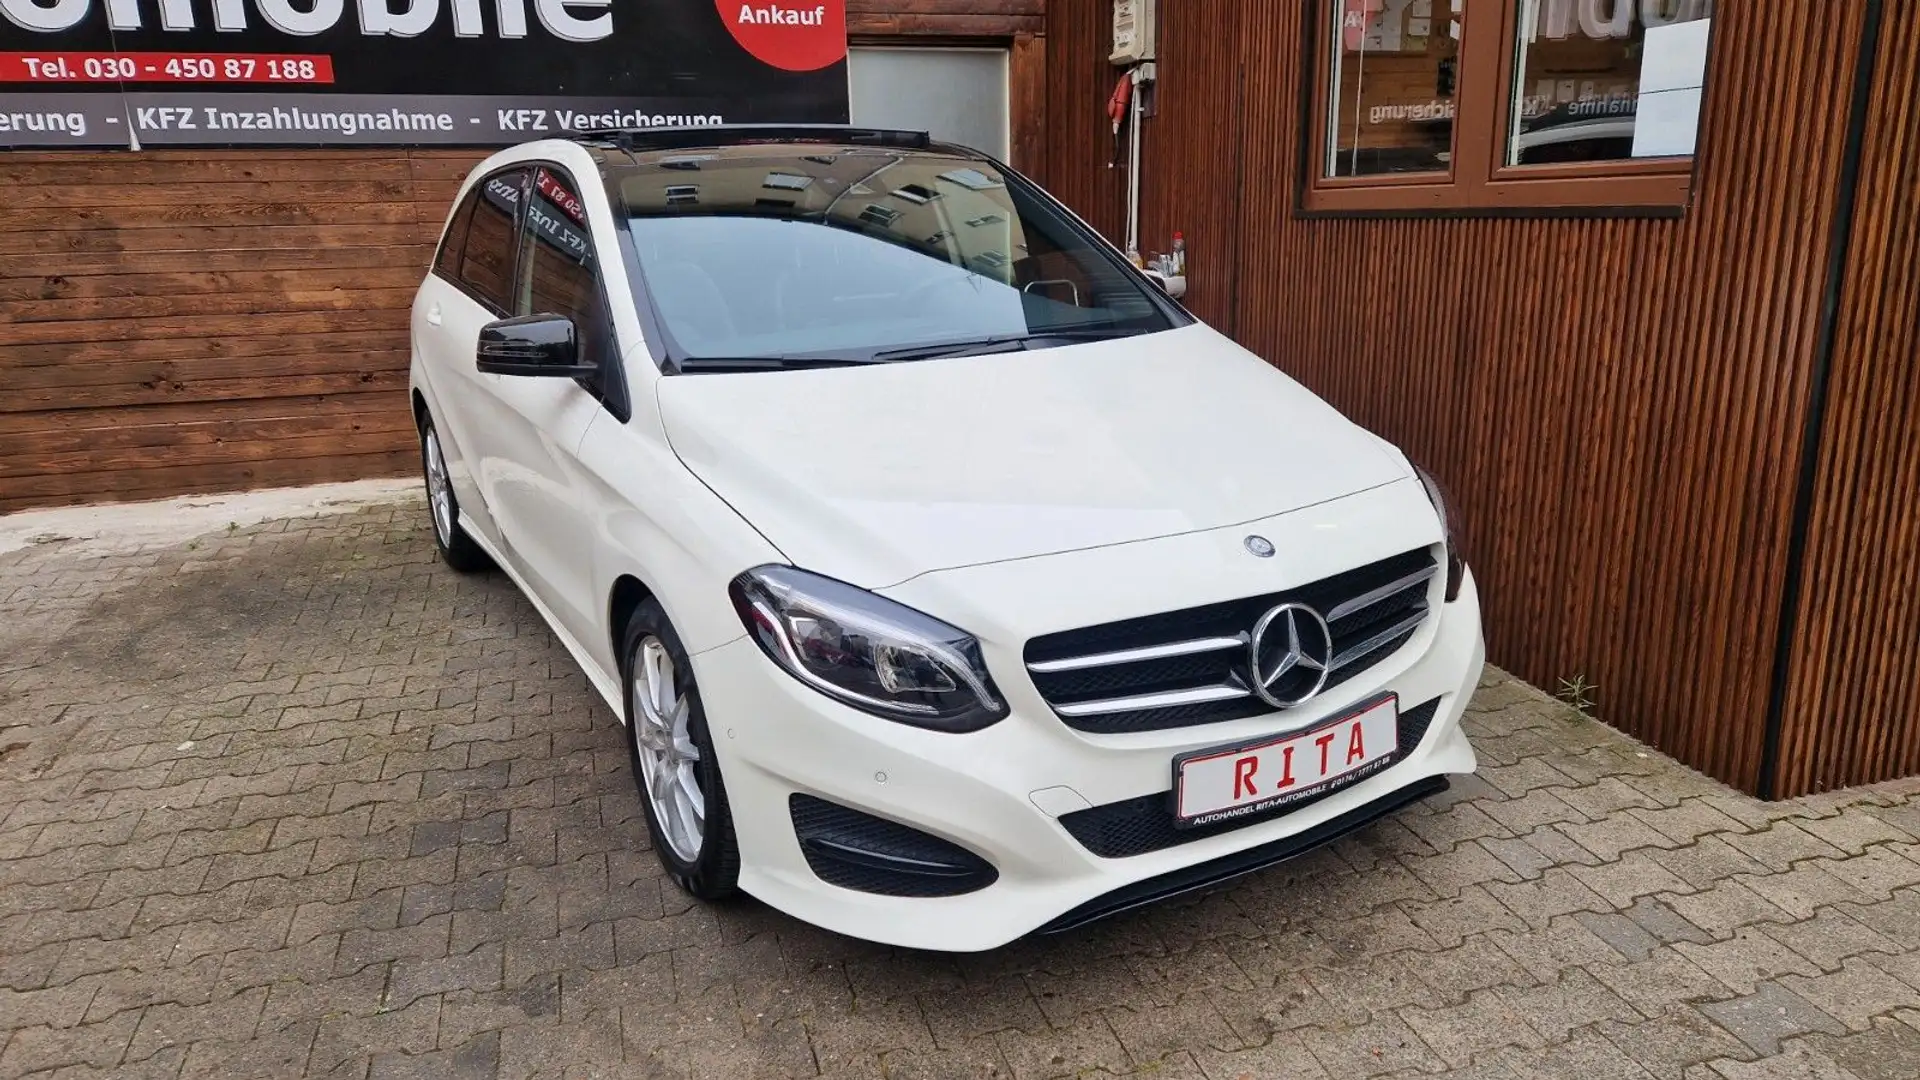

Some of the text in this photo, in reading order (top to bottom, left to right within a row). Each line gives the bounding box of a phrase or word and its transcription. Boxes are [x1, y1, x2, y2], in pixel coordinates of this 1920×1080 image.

[738, 4, 825, 25] Ankauf
[22, 57, 76, 78] Tel.
[84, 58, 136, 79] 030
[165, 58, 216, 79] 450
[224, 60, 256, 79] 87
[268, 60, 315, 80] 188
[137, 107, 197, 130] KFZ
[204, 107, 453, 135] Inzahlungnahme
[498, 110, 548, 131] KFZ
[1193, 805, 1255, 826] AUTOHANDEL
